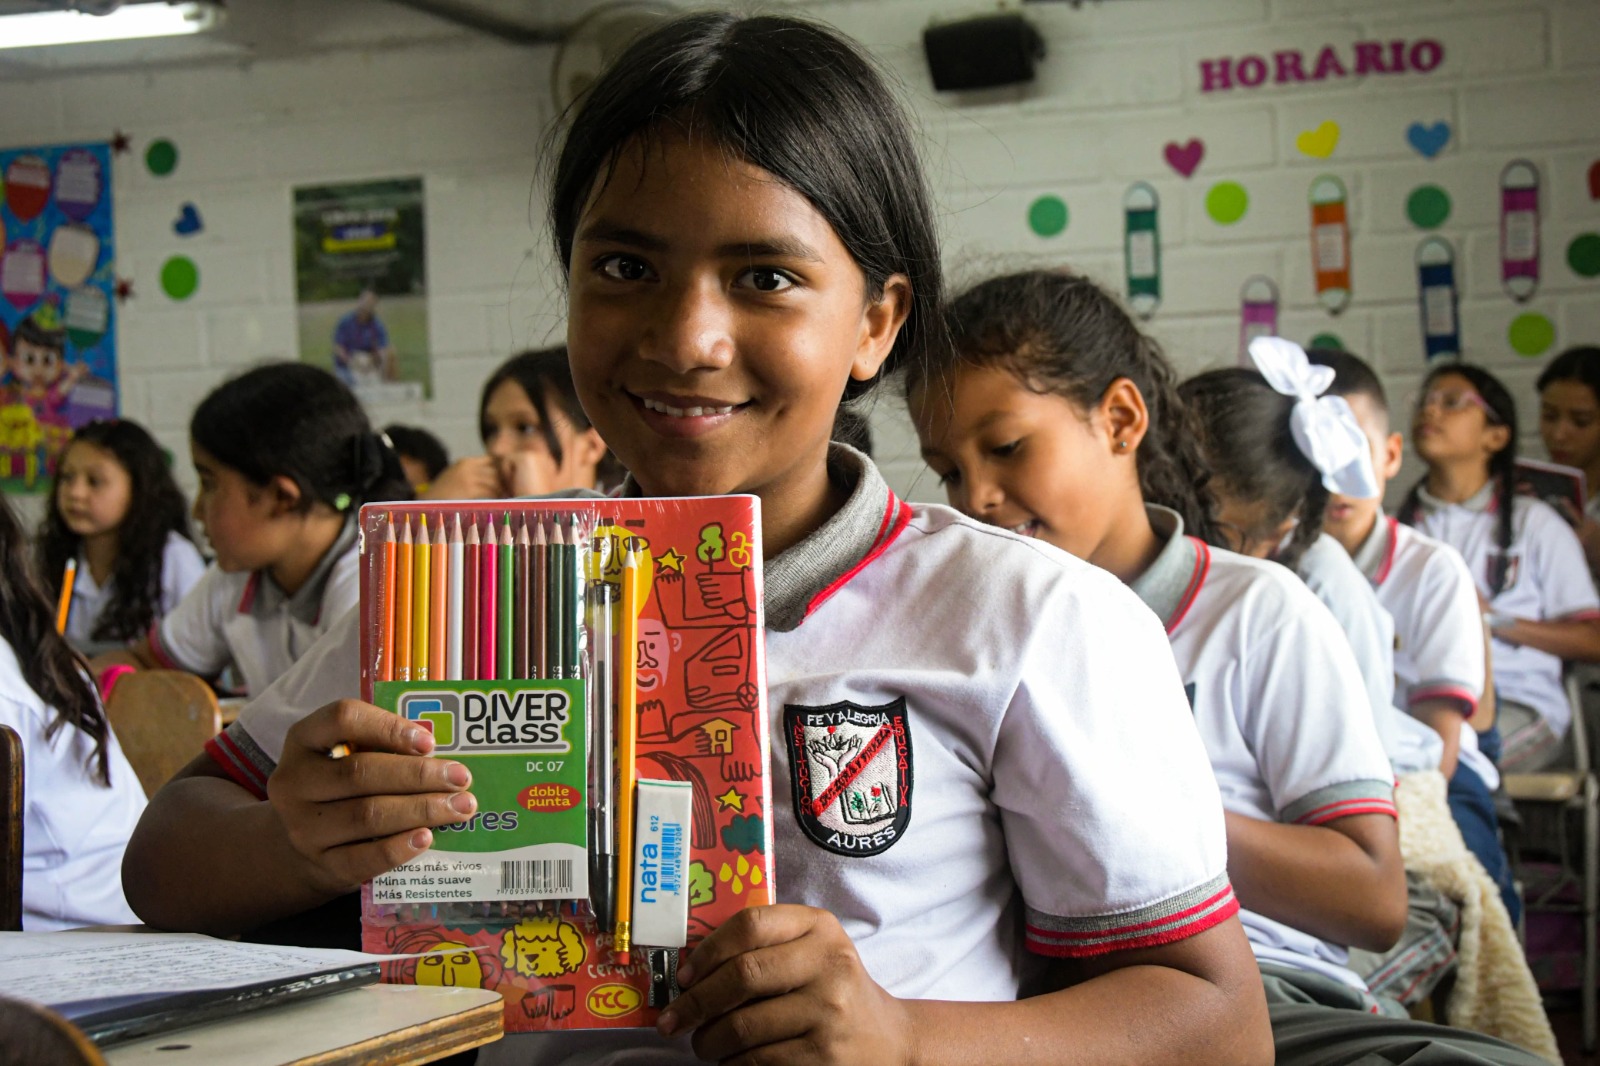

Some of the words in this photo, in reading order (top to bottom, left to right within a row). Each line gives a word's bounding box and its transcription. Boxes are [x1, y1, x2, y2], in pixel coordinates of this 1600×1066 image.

[1199, 39, 1444, 92] HORARIO
[464, 693, 567, 722] DIVER
[807, 715, 824, 726] FE
[827, 713, 836, 724] Y
[838, 709, 890, 725] ALEGRIA
[466, 715, 559, 744] class
[526, 762, 544, 772] DC
[547, 761, 565, 772] 07
[893, 716, 909, 807] EDUCATIVA
[529, 786, 570, 797] doble
[527, 797, 572, 809] punta
[650, 815, 660, 832] 612
[827, 826, 897, 850] AURES
[424, 861, 449, 872] más
[452, 861, 482, 871] vivos
[640, 844, 659, 903] nata
[378, 876, 407, 886] Mina
[410, 875, 435, 885] más
[438, 876, 472, 885] suave
[378, 889, 403, 900] Más
[405, 889, 473, 899] Resistentes
